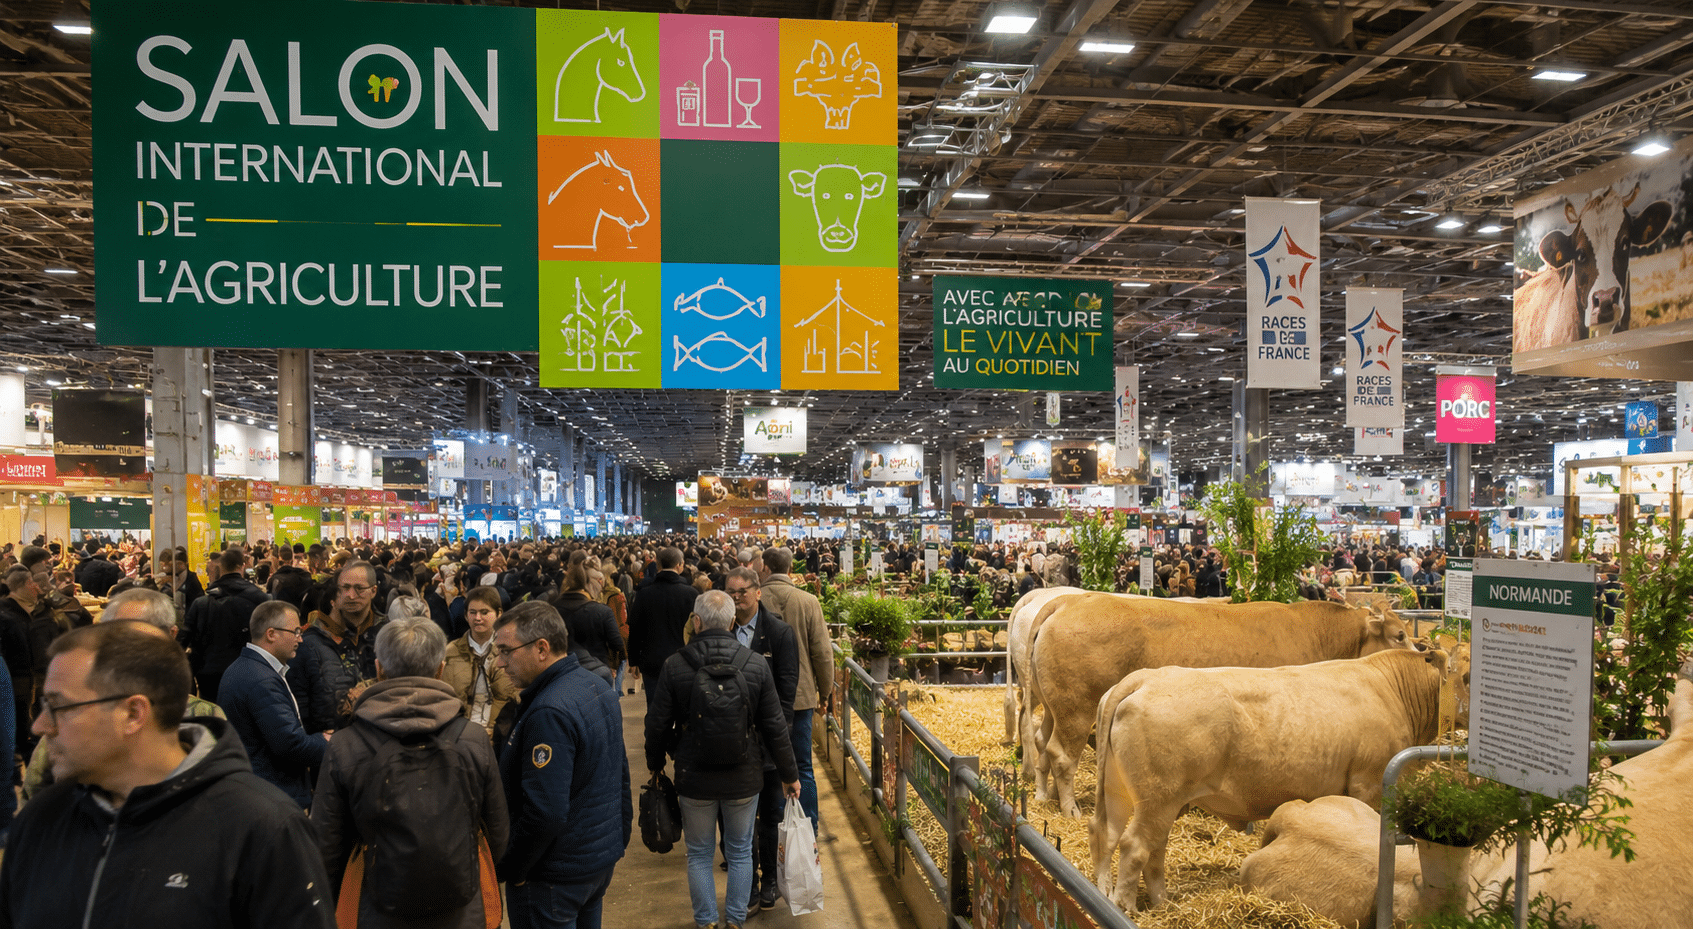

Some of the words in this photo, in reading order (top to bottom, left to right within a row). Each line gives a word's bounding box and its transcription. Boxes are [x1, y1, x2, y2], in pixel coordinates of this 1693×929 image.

[135, 35, 499, 131] SALON
[136, 141, 502, 187] INTERNATIONAL
[137, 201, 197, 237] DE
[137, 259, 504, 308] L'AGRICULTURE
[943, 290, 995, 306] AVEC
[943, 308, 1102, 328] L'AGRICULTURE
[1262, 316, 1306, 329] RACES
[943, 329, 976, 353] LE
[986, 330, 1102, 355] VIVANT
[1258, 346, 1310, 360] FRANCE
[943, 358, 969, 373] AU
[975, 358, 1080, 376] QUOTIDIEN
[1356, 375, 1392, 386] RACES
[1440, 399, 1490, 418] PORC
[1489, 584, 1572, 606] NORMANDE
